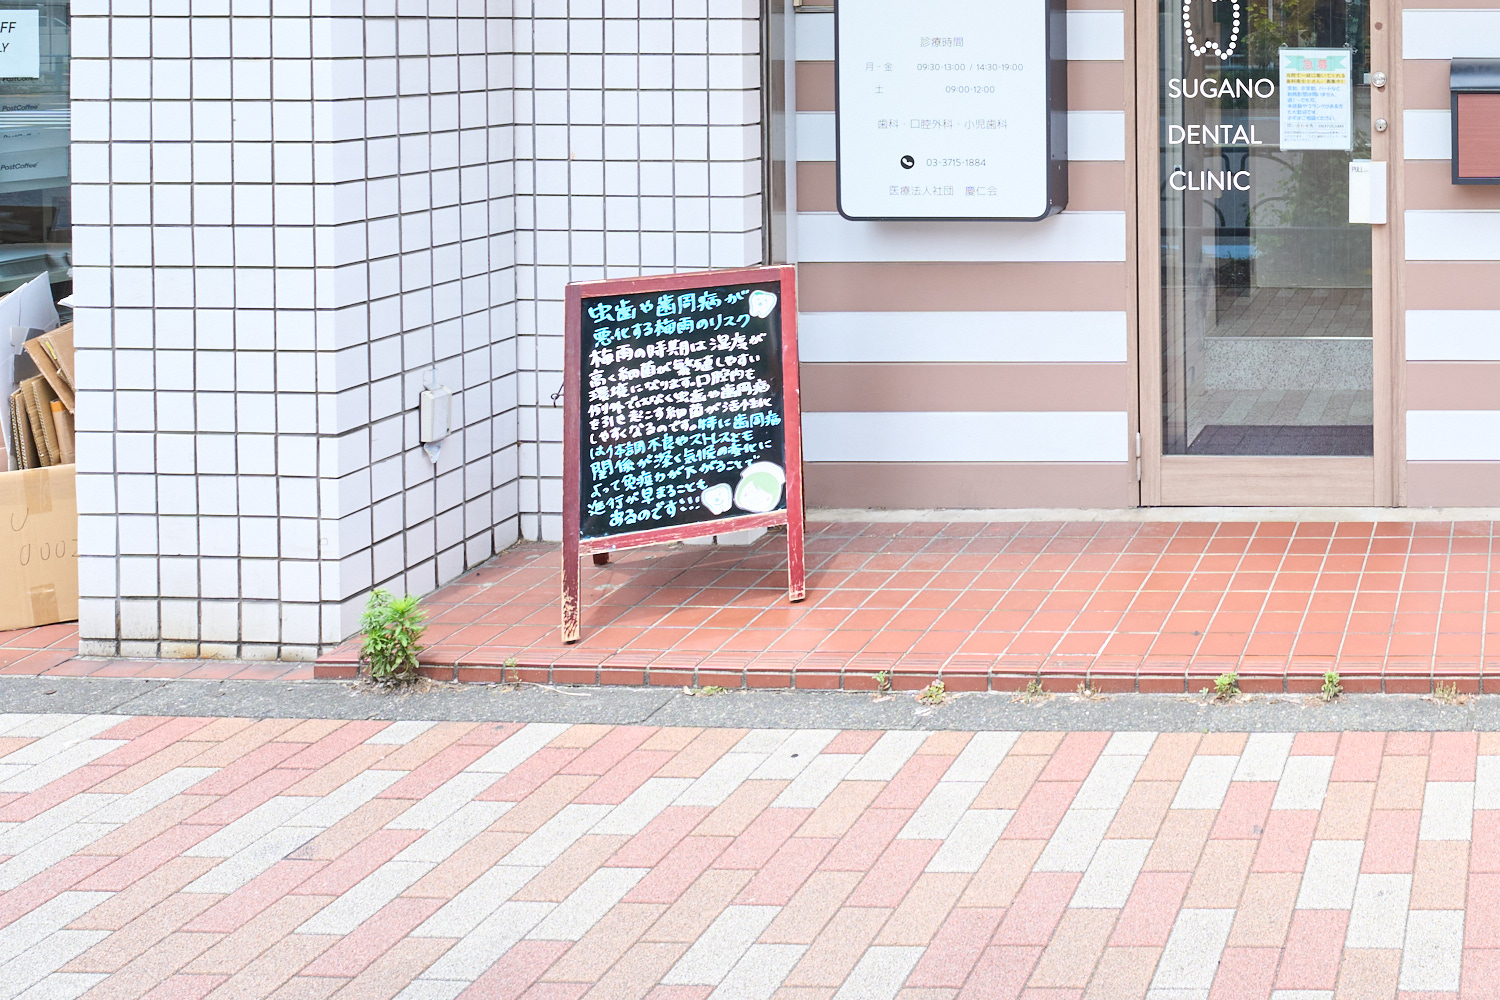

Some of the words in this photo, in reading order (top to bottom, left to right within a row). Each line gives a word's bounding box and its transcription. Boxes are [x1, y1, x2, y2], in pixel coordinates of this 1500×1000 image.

[920, 36, 964, 47] 診療時間
[875, 85, 884, 94] 土
[1168, 78, 1275, 99] SUGANO
[1168, 124, 1263, 145] DENTAL
[926, 158, 986, 167] 03-3715-1884
[1169, 170, 1251, 191] CLINIC
[588, 289, 749, 324] 虫歯や歯周病が
[593, 313, 750, 348] 悪化する梅雨のリスク
[588, 332, 767, 368] 梅雨の時期は湿度が
